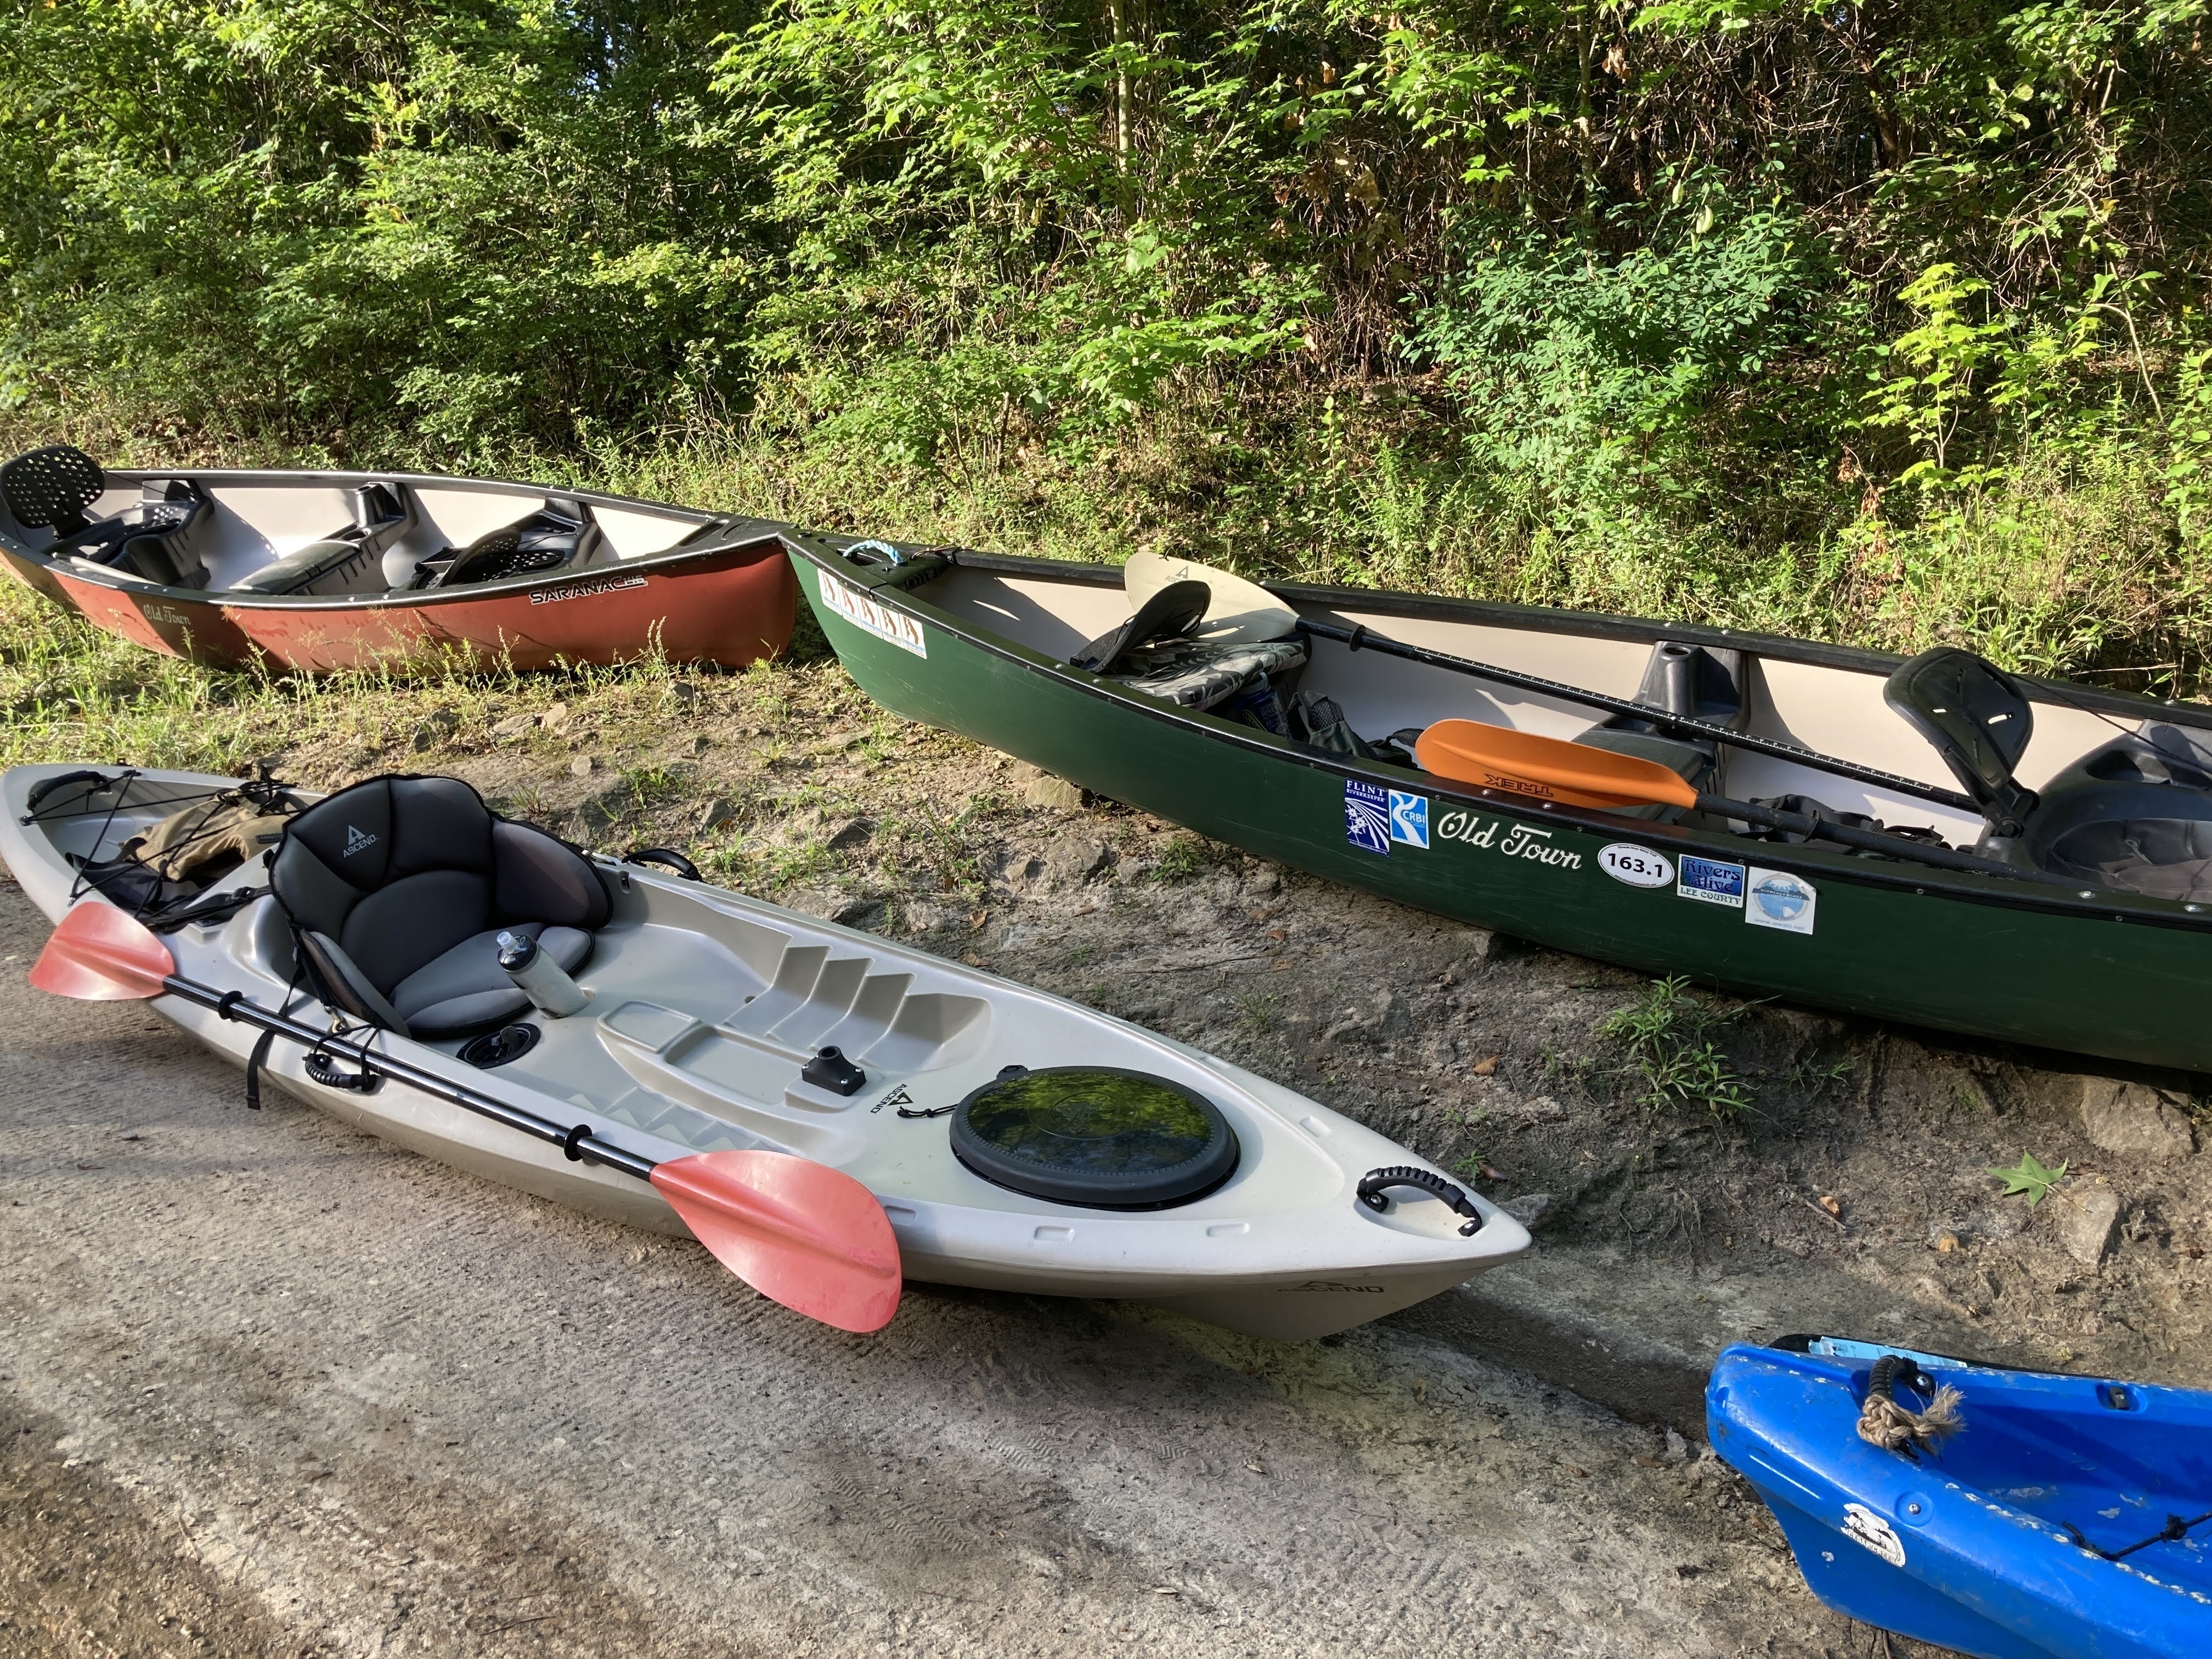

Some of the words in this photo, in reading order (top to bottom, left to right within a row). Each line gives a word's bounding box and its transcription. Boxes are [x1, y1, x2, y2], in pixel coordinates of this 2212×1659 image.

[529, 576, 628, 605] SARANAC
[144, 603, 163, 622] Old
[163, 605, 191, 625] Town
[1346, 780, 1384, 796] FLINT
[1346, 788, 1385, 803] RIVERKEEPER
[1484, 774, 1553, 797] TREK
[1403, 811, 1425, 824] CRBI
[343, 834, 376, 859] ASCEND
[1437, 811, 1499, 849] Old
[1500, 823, 1582, 870] Town
[1608, 853, 1663, 878] 163.1
[1684, 859, 1741, 881] Rivers
[1691, 873, 1734, 893] Alive
[1680, 887, 1697, 896] LEE
[1701, 891, 1741, 905] COUNTY
[870, 1084, 907, 1114] ASCEND
